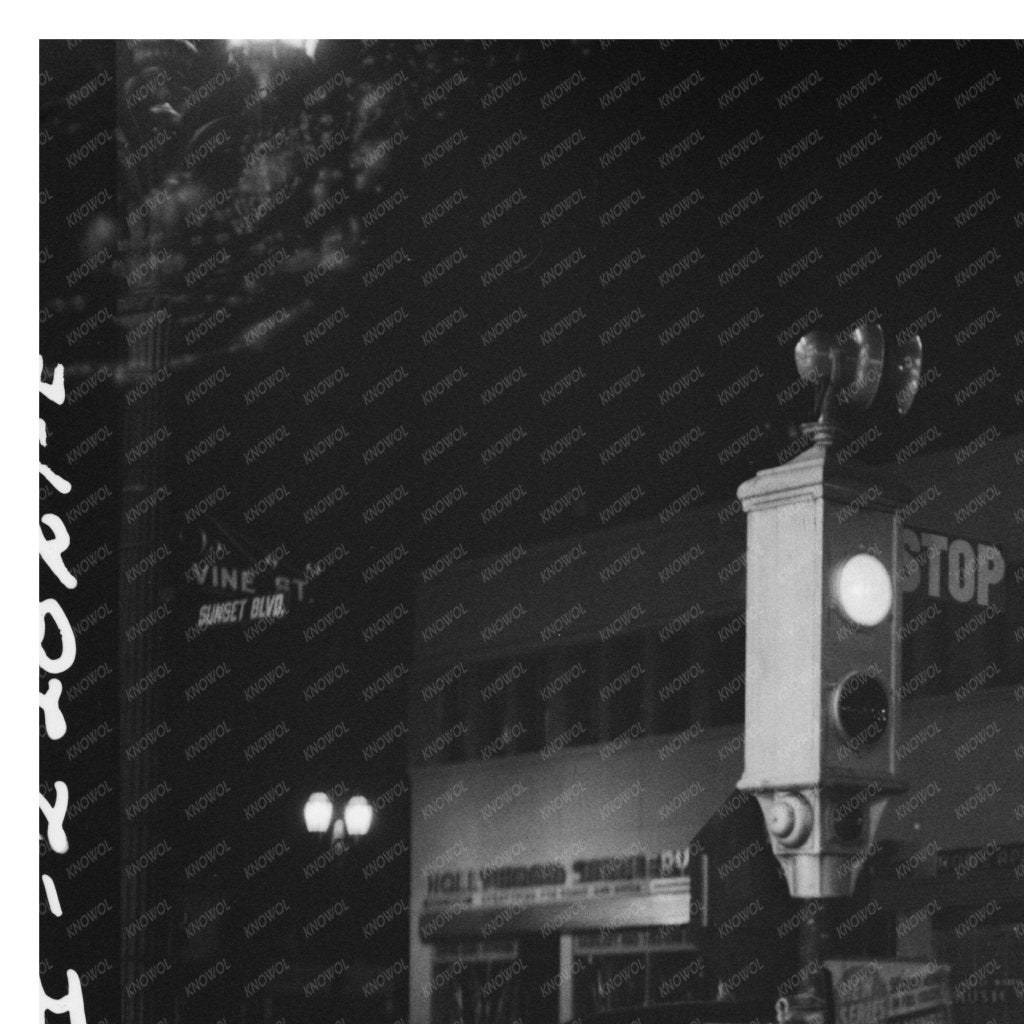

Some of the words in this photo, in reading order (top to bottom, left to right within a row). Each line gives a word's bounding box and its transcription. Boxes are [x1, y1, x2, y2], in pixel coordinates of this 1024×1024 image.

[192, 562, 255, 594] VINE
[901, 527, 1005, 606] STOP
[198, 599, 248, 627] SUNSET
[250, 593, 285, 620] BLVD.
